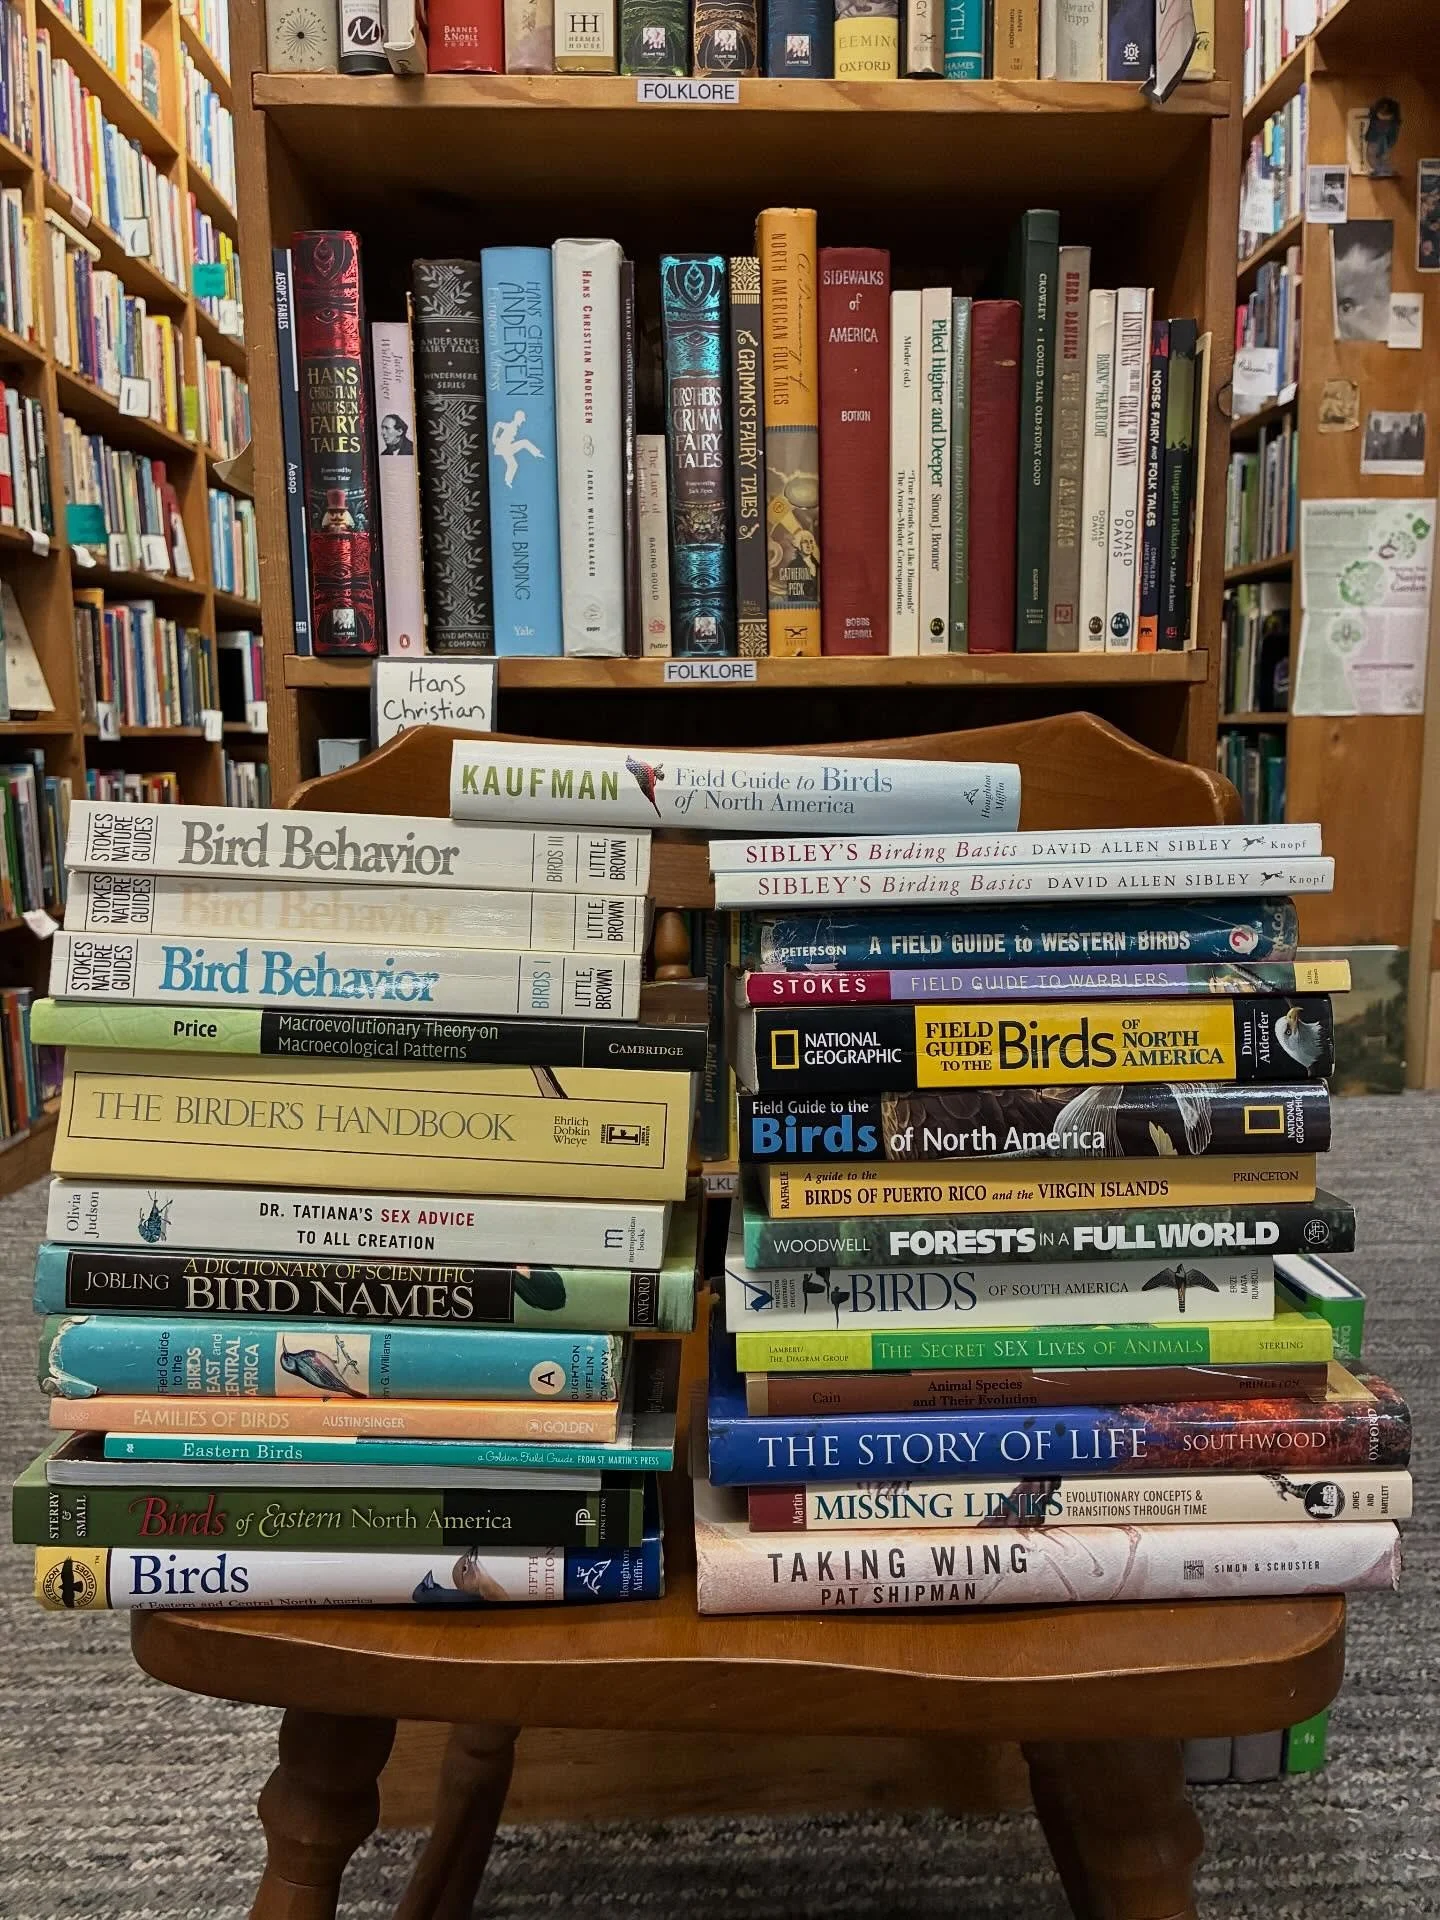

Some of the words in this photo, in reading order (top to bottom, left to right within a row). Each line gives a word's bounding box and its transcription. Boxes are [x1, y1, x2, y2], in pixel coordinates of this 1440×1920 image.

[839, 60, 891, 73] OXFORD
[643, 83, 735, 99] FOLKLORE
[771, 233, 787, 272] NORTH
[275, 271, 286, 301] AESOP'S
[582, 270, 592, 298] HANS
[823, 270, 884, 286] SIDEWALKS
[527, 281, 543, 317] HANS
[772, 279, 788, 340] AMERICAN
[849, 293, 863, 311] of
[277, 302, 289, 329] FABLES
[498, 282, 528, 396] ANDERSEN
[583, 305, 593, 364] CHRISTIAN
[829, 327, 878, 343] AMERICA
[932, 319, 948, 353] Piled
[528, 324, 544, 396] CHRISTIAN
[772, 346, 788, 376] FOLK
[308, 367, 358, 385] HANS
[737, 349, 757, 417] GRIMM'S
[927, 356, 948, 404] Higher
[310, 387, 357, 400] CHRISTIAN
[584, 370, 594, 424] ANDERSEN
[673, 386, 722, 407] BROTHERS
[772, 376, 789, 406] TALES
[310, 401, 358, 414] ANDERSEN
[673, 408, 723, 433] GRIMM
[841, 410, 871, 422] BOTKIN
[931, 407, 948, 434] and
[310, 416, 359, 434] FAIRY
[312, 437, 360, 454] TALES
[675, 433, 722, 452] FAIRY
[739, 421, 757, 470] FAIRY
[675, 453, 723, 468] TALES
[927, 437, 946, 487] Deeper
[288, 463, 298, 494] Aesop
[741, 474, 758, 518] TALES
[510, 504, 527, 536] PAUL
[1113, 519, 1123, 557] DAVIS
[1123, 510, 1134, 567] DONALD
[512, 542, 530, 601] BINDING
[408, 666, 466, 696] Hans
[668, 664, 753, 679] FOLKLORE
[383, 699, 485, 721] Christian
[462, 764, 619, 801] KAUFMAN
[675, 767, 725, 787] Field
[731, 770, 790, 790] Guide
[796, 774, 815, 791] to
[820, 766, 893, 793] Birds
[674, 789, 698, 814] of
[704, 790, 763, 811] North
[770, 792, 856, 815] America
[91, 813, 113, 862] STOKES
[111, 815, 133, 862] NATURE
[131, 816, 153, 862] GUIDES
[178, 820, 269, 868] Bird
[279, 824, 460, 876] Behavior
[746, 843, 858, 863] SIBLEY'S
[868, 843, 946, 863] Birding
[955, 841, 1018, 858] Basics
[1031, 842, 1092, 856] DAVID
[1101, 840, 1159, 854] ALLEN
[1168, 838, 1232, 852] SIBLEY
[1270, 840, 1306, 852] Knopf
[781, 946, 847, 958] PETERSON
[869, 936, 882, 955] A
[891, 935, 942, 954] FIELD
[951, 934, 1005, 953] GUIDE
[1014, 934, 1033, 952] to
[1041, 932, 1126, 953] WESTERN
[1137, 930, 1191, 951] BIRDS
[159, 945, 250, 993] Bird
[259, 950, 440, 1002] Behavior
[773, 978, 867, 995] STOKES
[911, 976, 963, 992] FIELD
[971, 975, 1028, 991] GUIDE
[1037, 974, 1061, 988] TO
[1069, 972, 1169, 988] WARBLERS
[173, 1020, 218, 1038] Price
[279, 1016, 420, 1040] Macroevolutionary
[425, 1021, 476, 1041] Theory
[479, 1026, 499, 1040] on
[925, 1021, 994, 1039] FIELD
[1122, 1019, 1140, 1030] OF
[278, 1037, 399, 1058] Macroecological
[403, 1042, 467, 1058] Patterns
[608, 1043, 684, 1056] CAMBRIDGE
[804, 1031, 882, 1048] NATIONAL
[925, 1041, 993, 1057] GUIDE
[1000, 1017, 1115, 1070] Birds
[1122, 1030, 1199, 1048] NORTH
[804, 1048, 902, 1065] GEOGRAPHIC
[940, 1060, 960, 1072] TO
[961, 1060, 993, 1071] THE
[1121, 1048, 1225, 1067] AMERICA
[93, 1091, 163, 1122] THE
[176, 1095, 304, 1130] BIRDER'S
[316, 1104, 516, 1141] HANDBOOK
[554, 1115, 589, 1127] Ehrlich
[553, 1125, 590, 1136] Dobkin
[553, 1135, 588, 1147] Wheye
[1233, 1170, 1299, 1182] PRINCETON
[804, 1188, 852, 1205] BIRDS
[857, 1188, 878, 1203] OF
[883, 1186, 943, 1203] PUERTO
[949, 1185, 987, 1201] RICO
[992, 1190, 1013, 1201] and
[1017, 1189, 1033, 1200] the
[1038, 1183, 1096, 1199] VIRGIN
[1101, 1180, 1169, 1197] ISLANDS
[260, 1203, 285, 1217] DR.
[293, 1204, 373, 1221] TATIANA'S
[381, 1209, 410, 1223] SEX
[418, 1211, 475, 1226] ADVICE
[297, 1230, 316, 1244] TO
[323, 1231, 350, 1246] ALL
[357, 1233, 434, 1250] CREATION
[773, 1238, 871, 1253] WOODWELL
[889, 1227, 1037, 1256] FORESTS
[1039, 1233, 1055, 1246] IN
[1058, 1232, 1070, 1246] A
[1073, 1225, 1156, 1251] FULL
[1158, 1221, 1280, 1248] WORLD
[85, 1271, 169, 1291] JOBLING
[184, 1258, 198, 1273] A
[204, 1258, 330, 1278] DICTIONARY
[335, 1263, 361, 1279] OF
[365, 1264, 475, 1283] SCIENTIFIC
[182, 1276, 299, 1312] BIRD
[310, 1281, 474, 1319] NAMES
[183, 1443, 250, 1458] Eastern
[257, 1445, 303, 1460] Birds
[759, 1435, 840, 1468] THE
[858, 1432, 985, 1465] STORY
[1001, 1430, 1051, 1462] OF
[1071, 1428, 1148, 1460] LIFE
[1183, 1431, 1326, 1451] SOUTHWOOD
[129, 1493, 225, 1537] Birds
[236, 1514, 254, 1537] of
[259, 1503, 341, 1538] Eastern
[351, 1508, 417, 1529] North
[425, 1509, 513, 1530] America
[815, 1494, 953, 1520] MISSING
[964, 1491, 1064, 1518] LINKS
[129, 1553, 249, 1596] Birds
[768, 1548, 906, 1583] TAKING
[931, 1544, 1028, 1577] WING
[1214, 1563, 1248, 1573] SIMON
[1254, 1563, 1261, 1573] &
[1267, 1560, 1320, 1572] SCHUSTER
[821, 1588, 859, 1605] PAT
[874, 1583, 977, 1605] SHIPMAN
